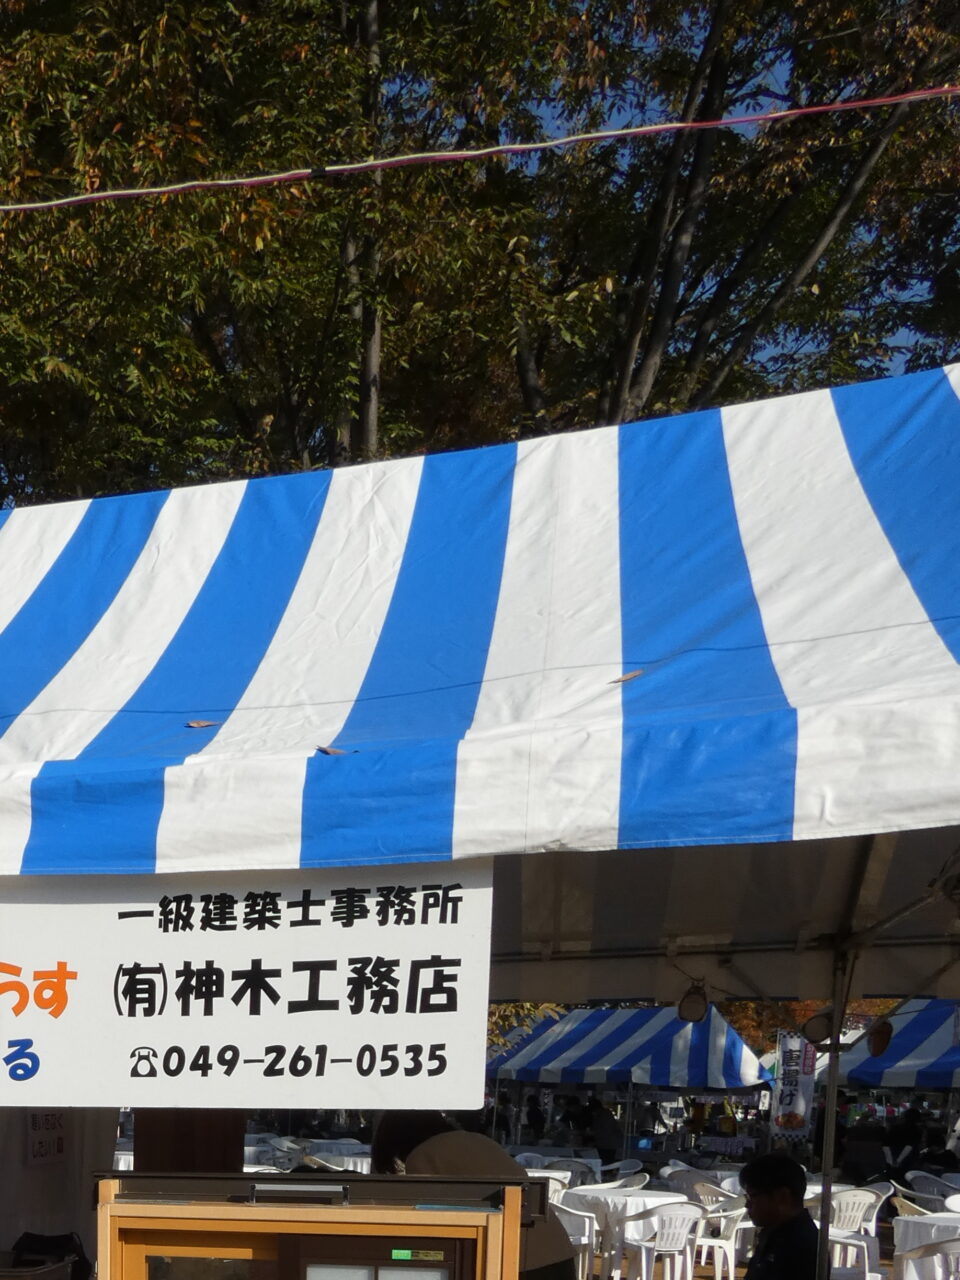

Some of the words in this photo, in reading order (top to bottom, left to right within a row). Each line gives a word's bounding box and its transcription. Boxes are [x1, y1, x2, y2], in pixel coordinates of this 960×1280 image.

[117, 883, 463, 933] 一級建築士事務所
